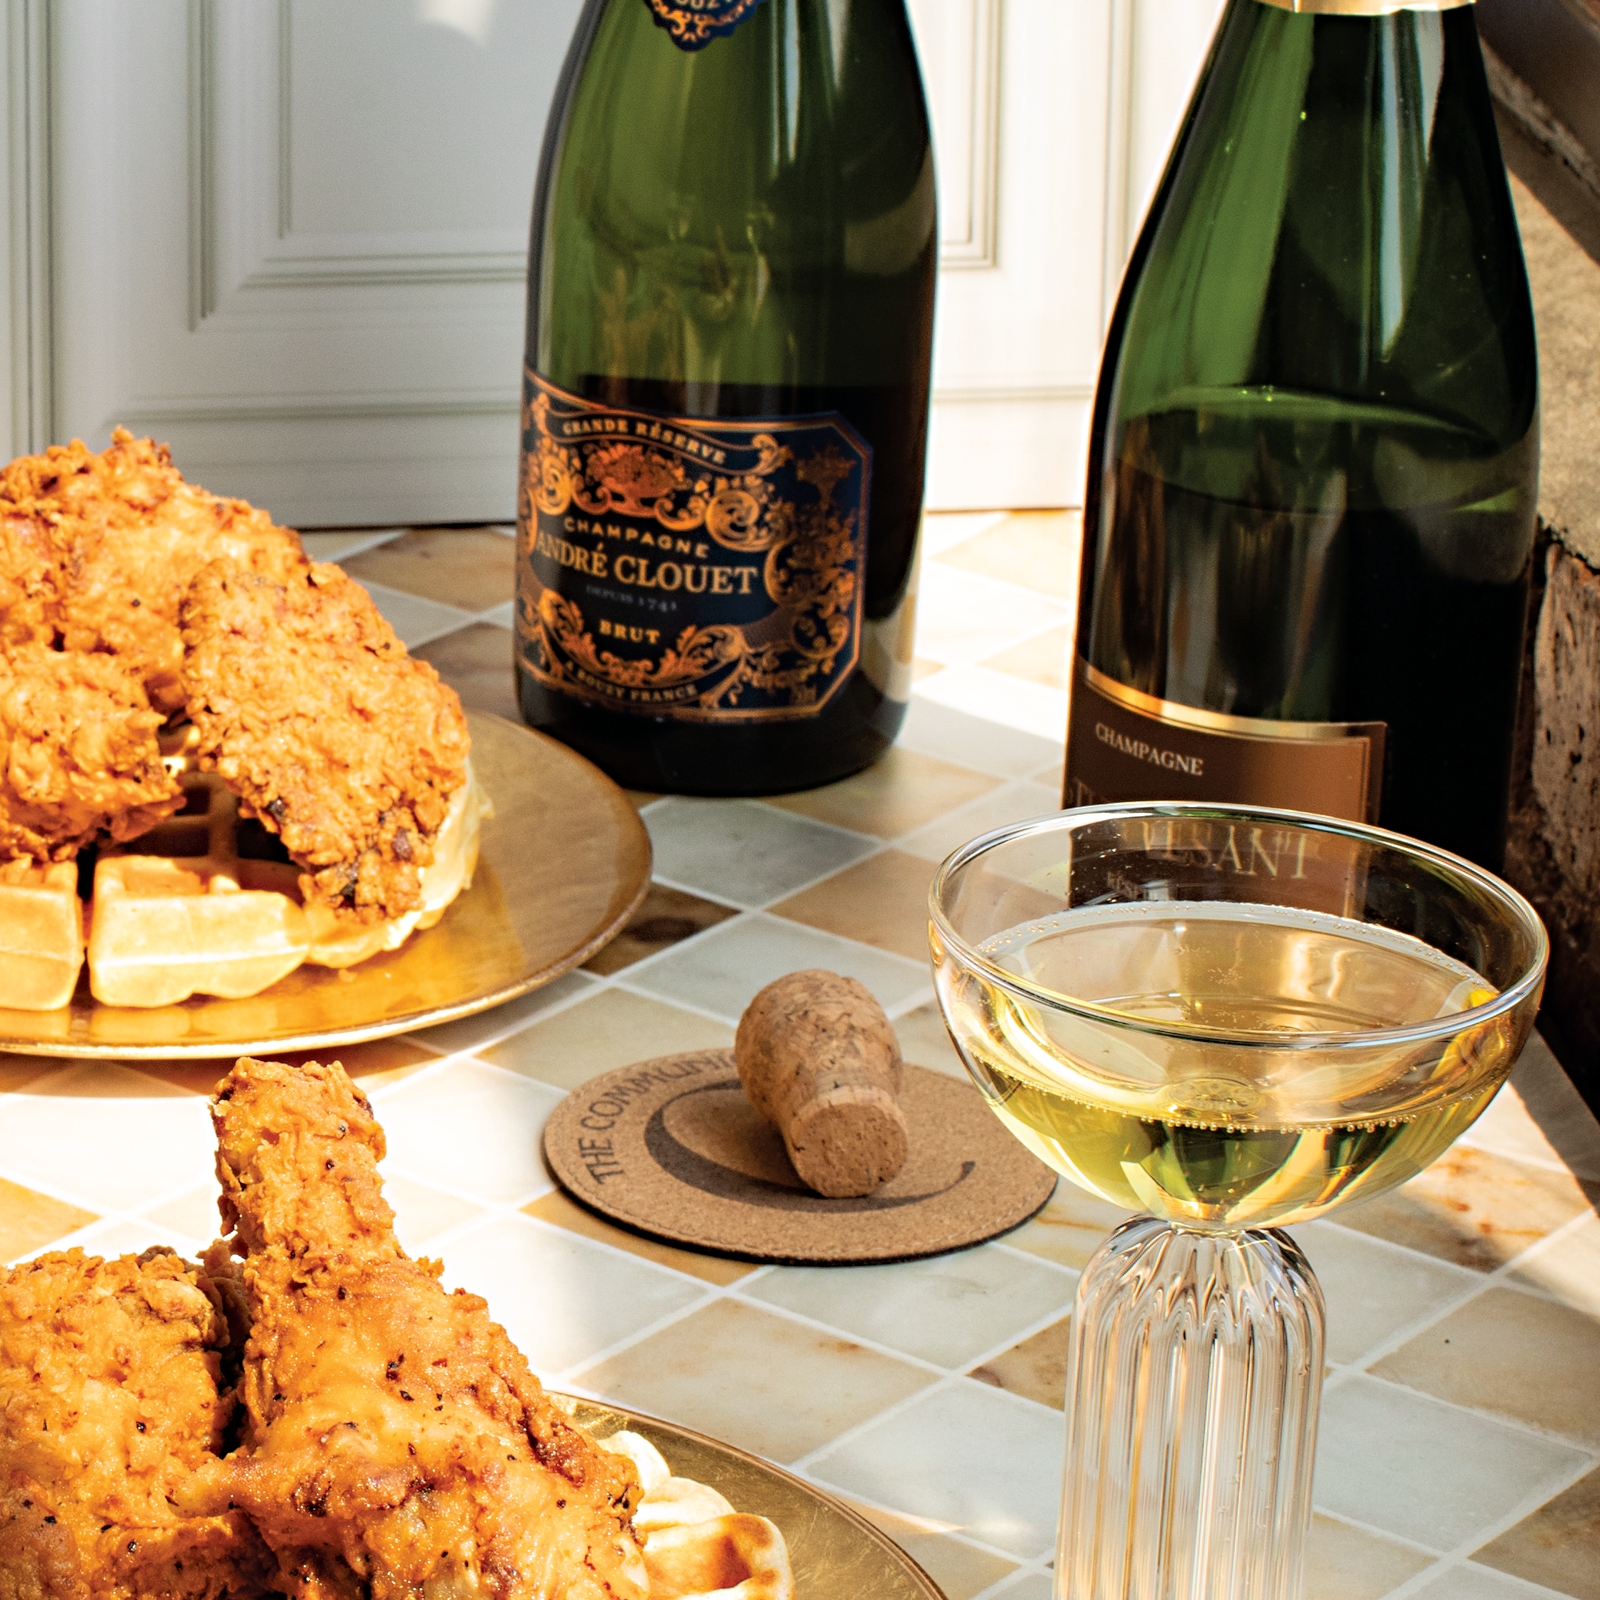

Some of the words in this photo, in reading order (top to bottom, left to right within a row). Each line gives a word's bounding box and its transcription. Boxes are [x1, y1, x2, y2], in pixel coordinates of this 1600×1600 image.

[562, 418, 629, 436] GRANDE
[634, 422, 727, 465] RÉSERVE
[536, 529, 609, 579] ANDRÉ
[613, 553, 759, 595] CLOUET
[563, 516, 710, 560] CHAMPAGNE
[599, 618, 661, 645] BRUT
[1094, 722, 1204, 777] CHAMPAGNE
[578, 1137, 626, 1186] THE
